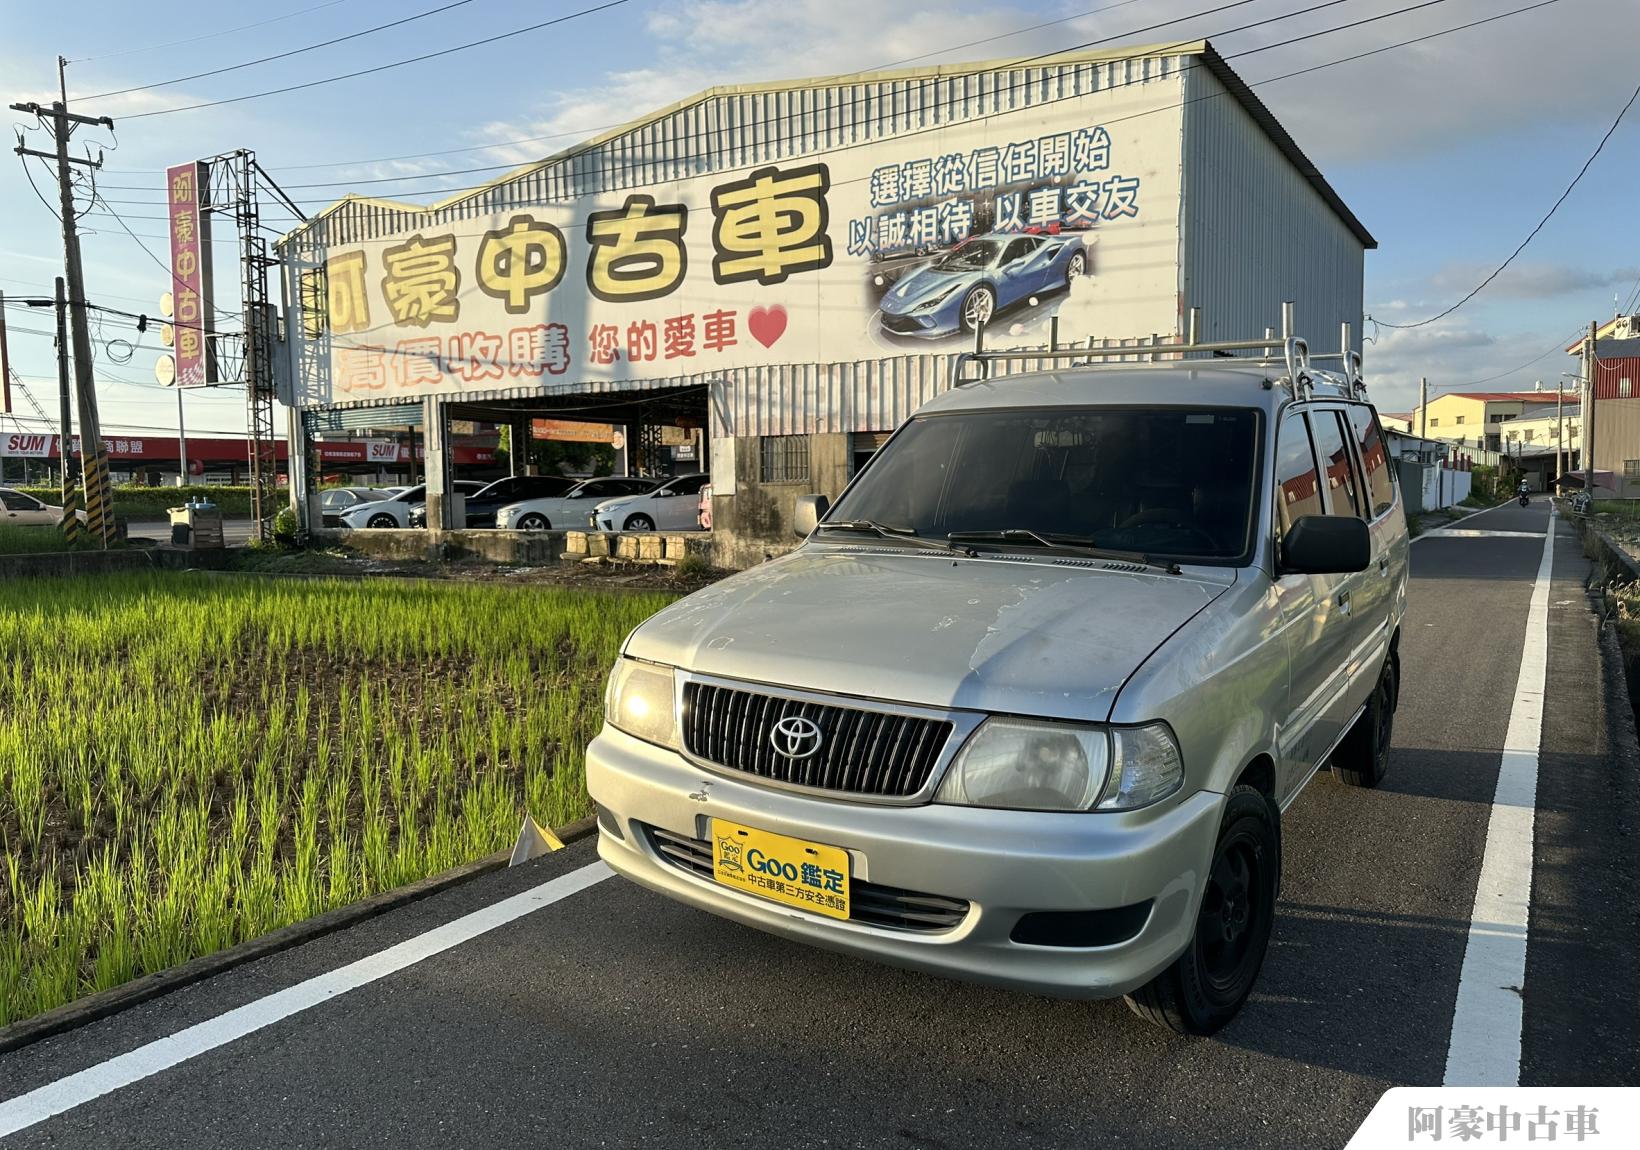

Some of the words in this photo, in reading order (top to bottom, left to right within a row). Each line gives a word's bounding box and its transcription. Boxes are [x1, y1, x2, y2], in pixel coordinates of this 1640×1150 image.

[870, 127, 1112, 208] 選擇從信任開始
[848, 199, 974, 256] 以誠相待
[992, 176, 1140, 234] 以車交友
[172, 171, 201, 361] 阿豪中古車
[302, 162, 834, 341] 阿豪中古車
[336, 323, 571, 392] 高價收購
[588, 309, 738, 366] 您的愛車
[8, 435, 46, 450] SUM
[372, 444, 395, 457] SUM
[721, 841, 740, 854] Goo
[747, 848, 798, 881] Goo
[801, 862, 844, 894] 鑑定
[748, 873, 846, 912] 中古車第三方安全憑證
